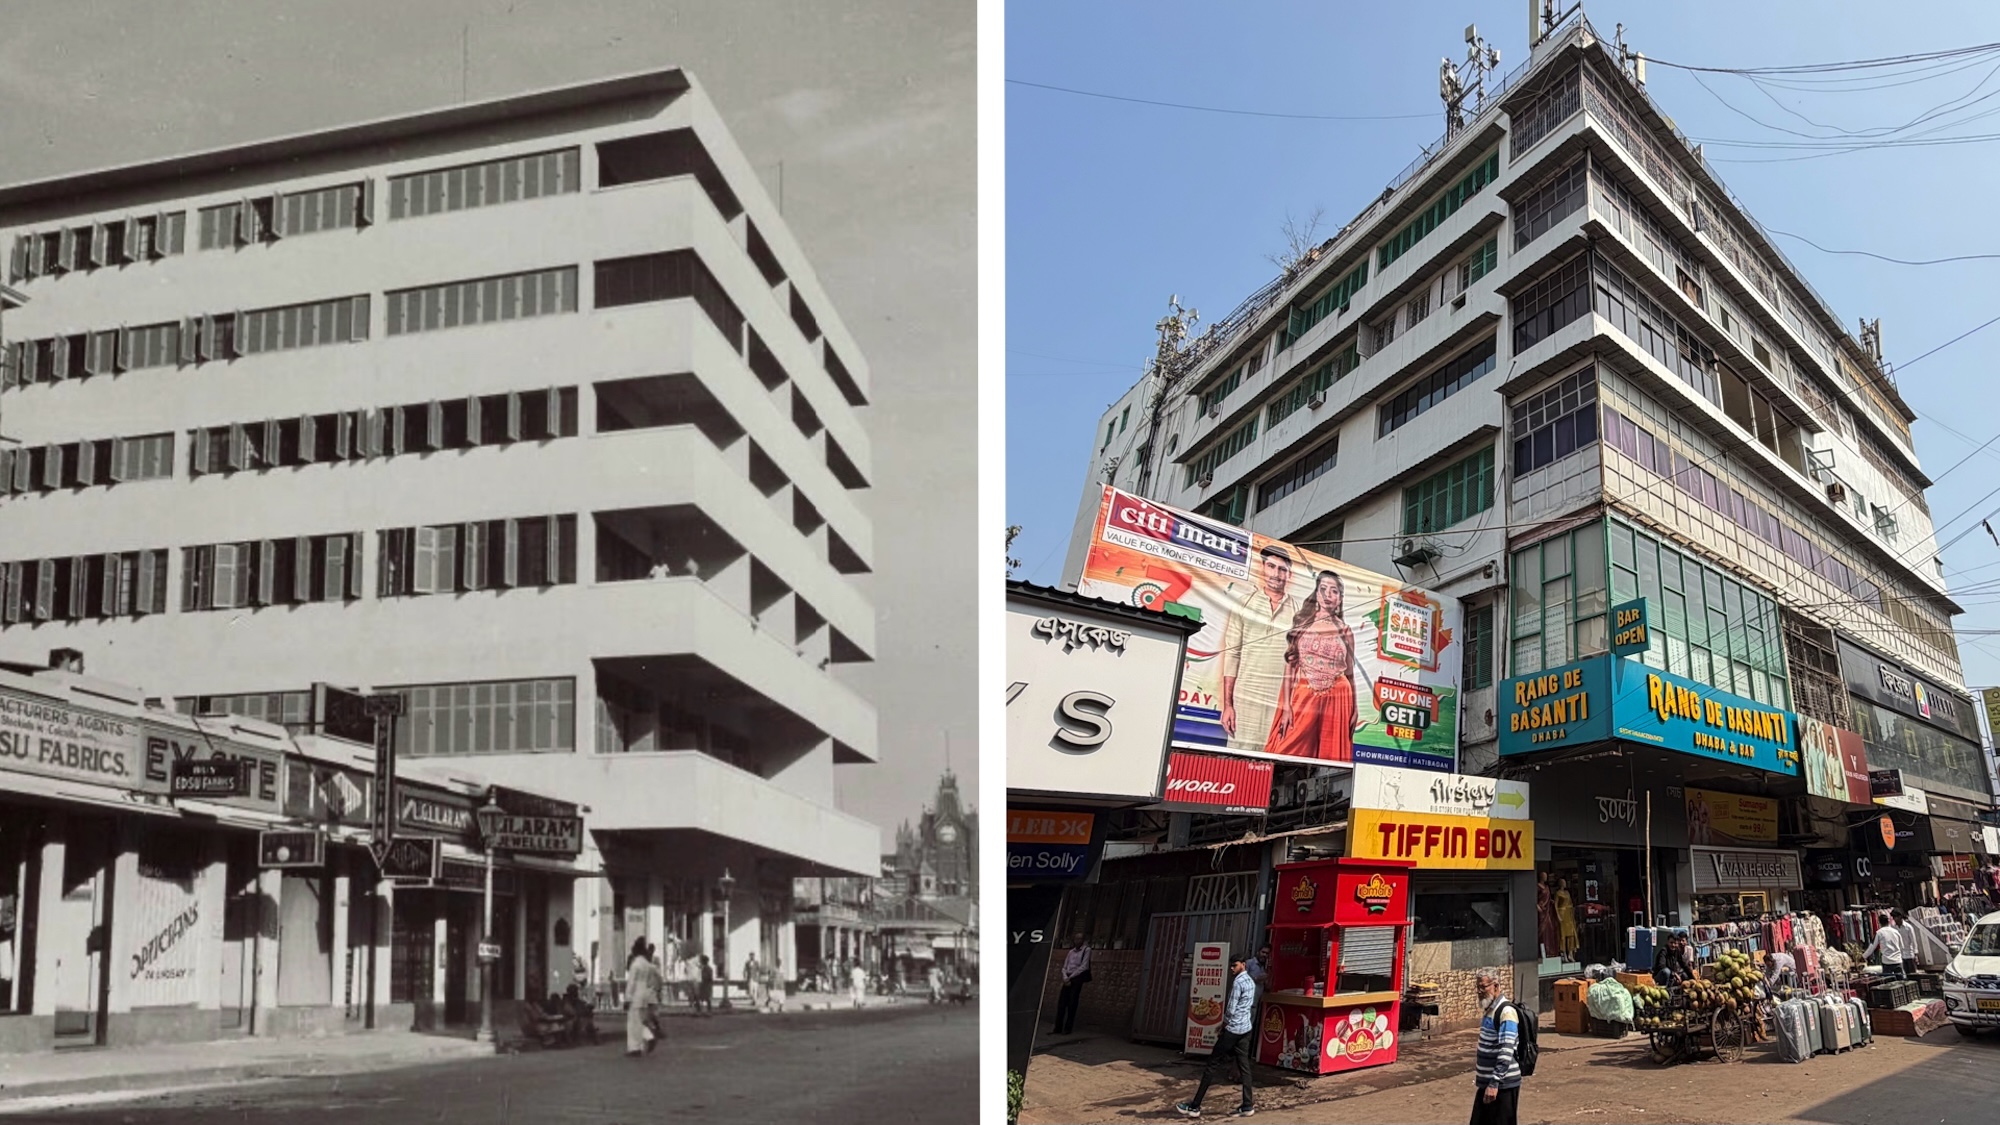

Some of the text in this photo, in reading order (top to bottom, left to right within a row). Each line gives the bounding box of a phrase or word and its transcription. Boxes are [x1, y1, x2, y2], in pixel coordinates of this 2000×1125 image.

[1120, 501, 1242, 556] citi mart
[1107, 531, 1246, 578] VALUE FOR MONEY RE-DEFINED
[1393, 602, 1429, 617] REPUBLIC DAY
[1617, 608, 1640, 628] BAR
[1391, 612, 1429, 641] SALE
[1615, 623, 1645, 646] OPEN
[1380, 686, 1432, 708] BUY ONE
[1515, 668, 1582, 707] RANG DE
[1385, 706, 1425, 727] GET 1
[1511, 691, 1588, 732] BASANTI
[1648, 673, 1788, 744] RANG DE BASANTI
[76, 715, 124, 736] AGENTS
[1393, 726, 1416, 740] FREE
[1532, 728, 1566, 743] DHABA
[0, 730, 130, 777] SU FABRICS.
[1695, 731, 1755, 758] DHABA & BAR
[1355, 750, 1449, 769] CHOWRINGHEE HATIBAGAN
[1167, 778, 1235, 794] WORLD
[1595, 788, 1638, 828] soch
[1007, 817, 1056, 836] LER
[1378, 822, 1523, 859] TIFFIN BOX
[1035, 851, 1079, 873] Solly
[1726, 862, 1748, 877] VAN
[1749, 863, 1788, 877] HEUSEN
[1856, 856, 1872, 878] CC
[130, 901, 198, 980] OPTICIANS
[1195, 968, 1223, 977] GUJARAT
[1196, 977, 1221, 986] SPECIALS
[1188, 1026, 1204, 1037] NOW
